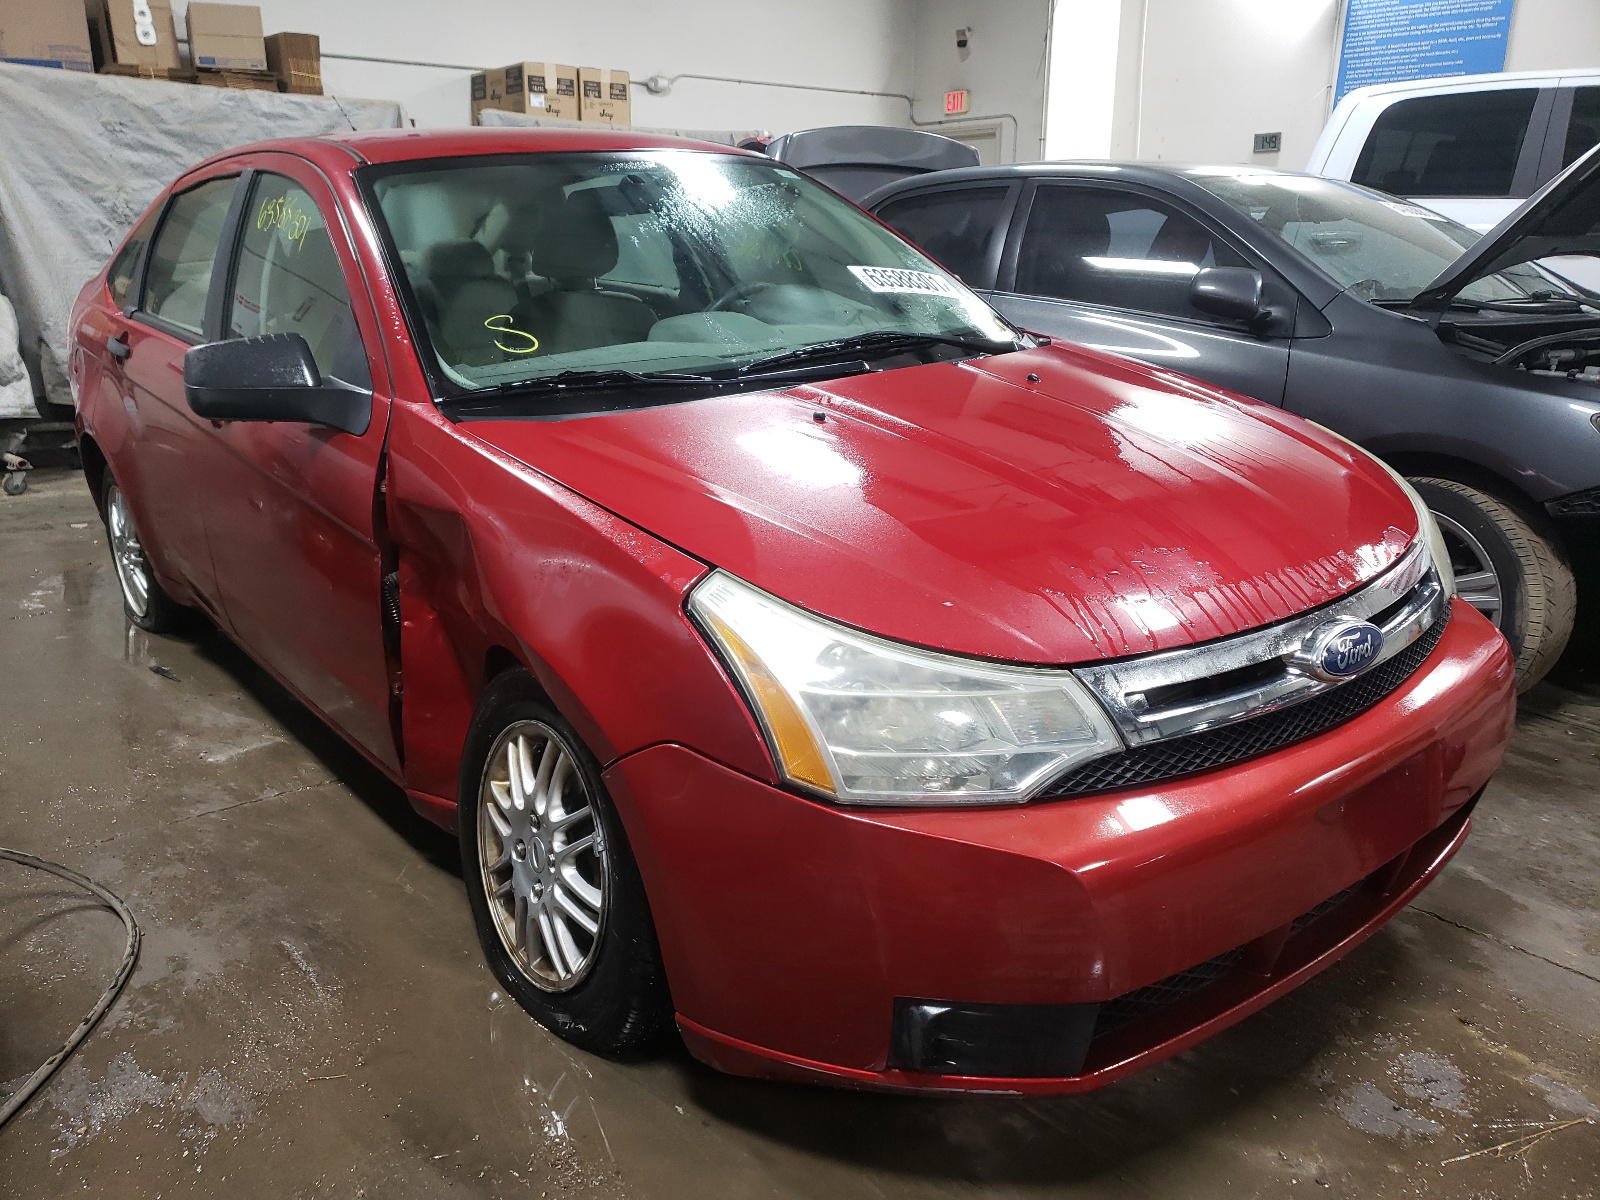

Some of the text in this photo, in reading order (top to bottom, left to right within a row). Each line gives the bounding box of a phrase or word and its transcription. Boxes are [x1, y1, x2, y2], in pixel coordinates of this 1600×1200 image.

[946, 92, 965, 112] EXIT
[862, 268, 948, 293] 63588301
[484, 314, 539, 354] S
[1338, 631, 1374, 670] Ford
